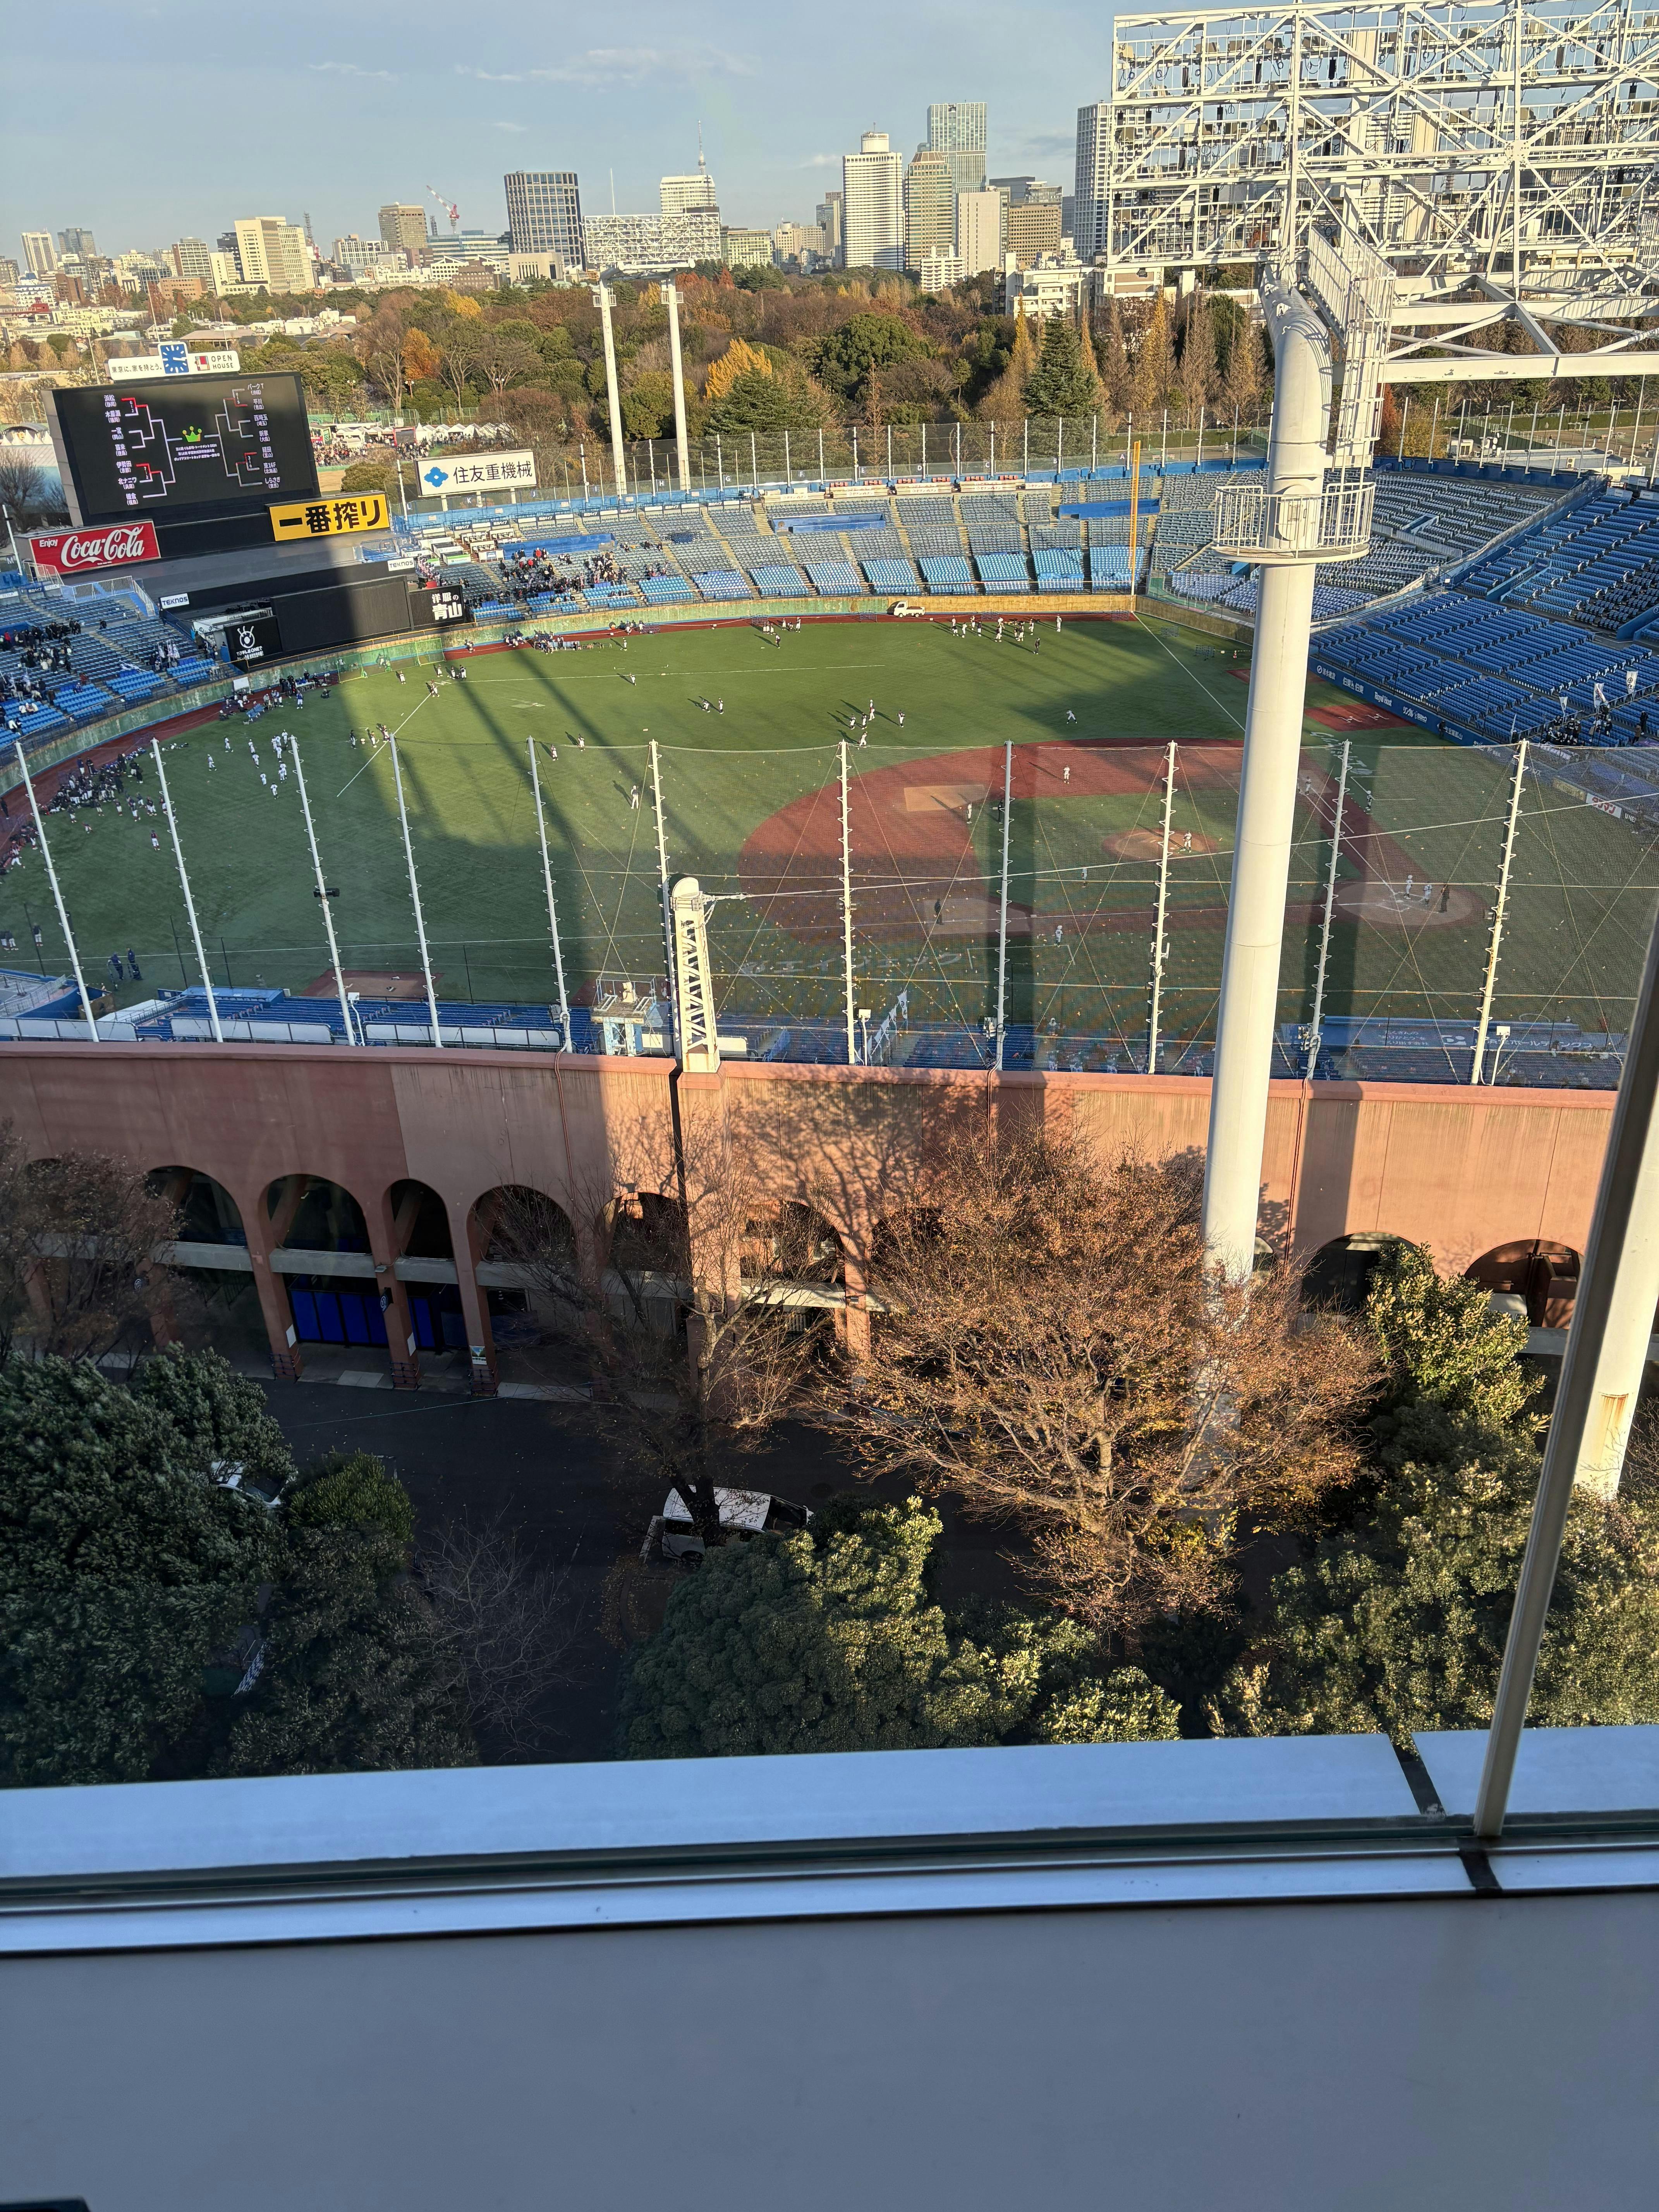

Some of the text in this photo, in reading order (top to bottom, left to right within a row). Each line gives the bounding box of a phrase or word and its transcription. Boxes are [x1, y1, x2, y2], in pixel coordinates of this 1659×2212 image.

[112, 363, 162, 374] 東京に、家を持とう。
[453, 461, 533, 484] 住友重機械
[279, 500, 380, 534] 一番搾り
[39, 526, 144, 567] Enjoy Coca-Cola
[389, 560, 413, 569] TEKNOS
[162, 596, 188, 606] TEKNOS
[432, 592, 459, 604] 洋服の
[432, 602, 462, 620] 青山
[1374, 691, 1392, 707] Royal Host
